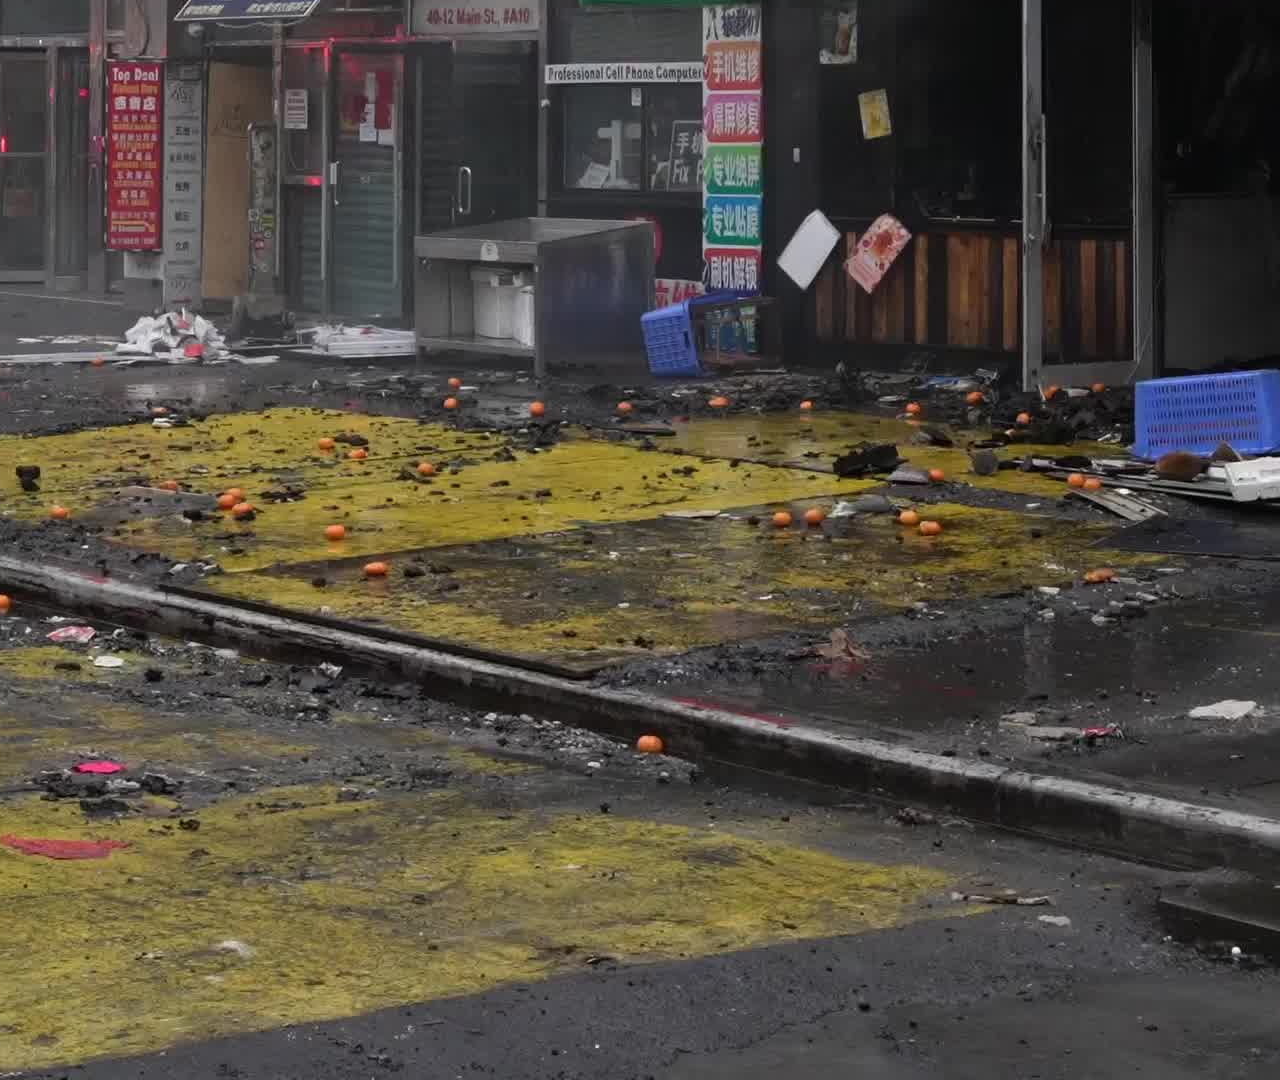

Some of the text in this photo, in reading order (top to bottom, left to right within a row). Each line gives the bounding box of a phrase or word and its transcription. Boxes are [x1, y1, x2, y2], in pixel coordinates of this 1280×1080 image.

[113, 67, 131, 83] Top
[548, 66, 603, 82] Professional
[605, 66, 624, 80] Cell
[625, 66, 654, 81] Phone
